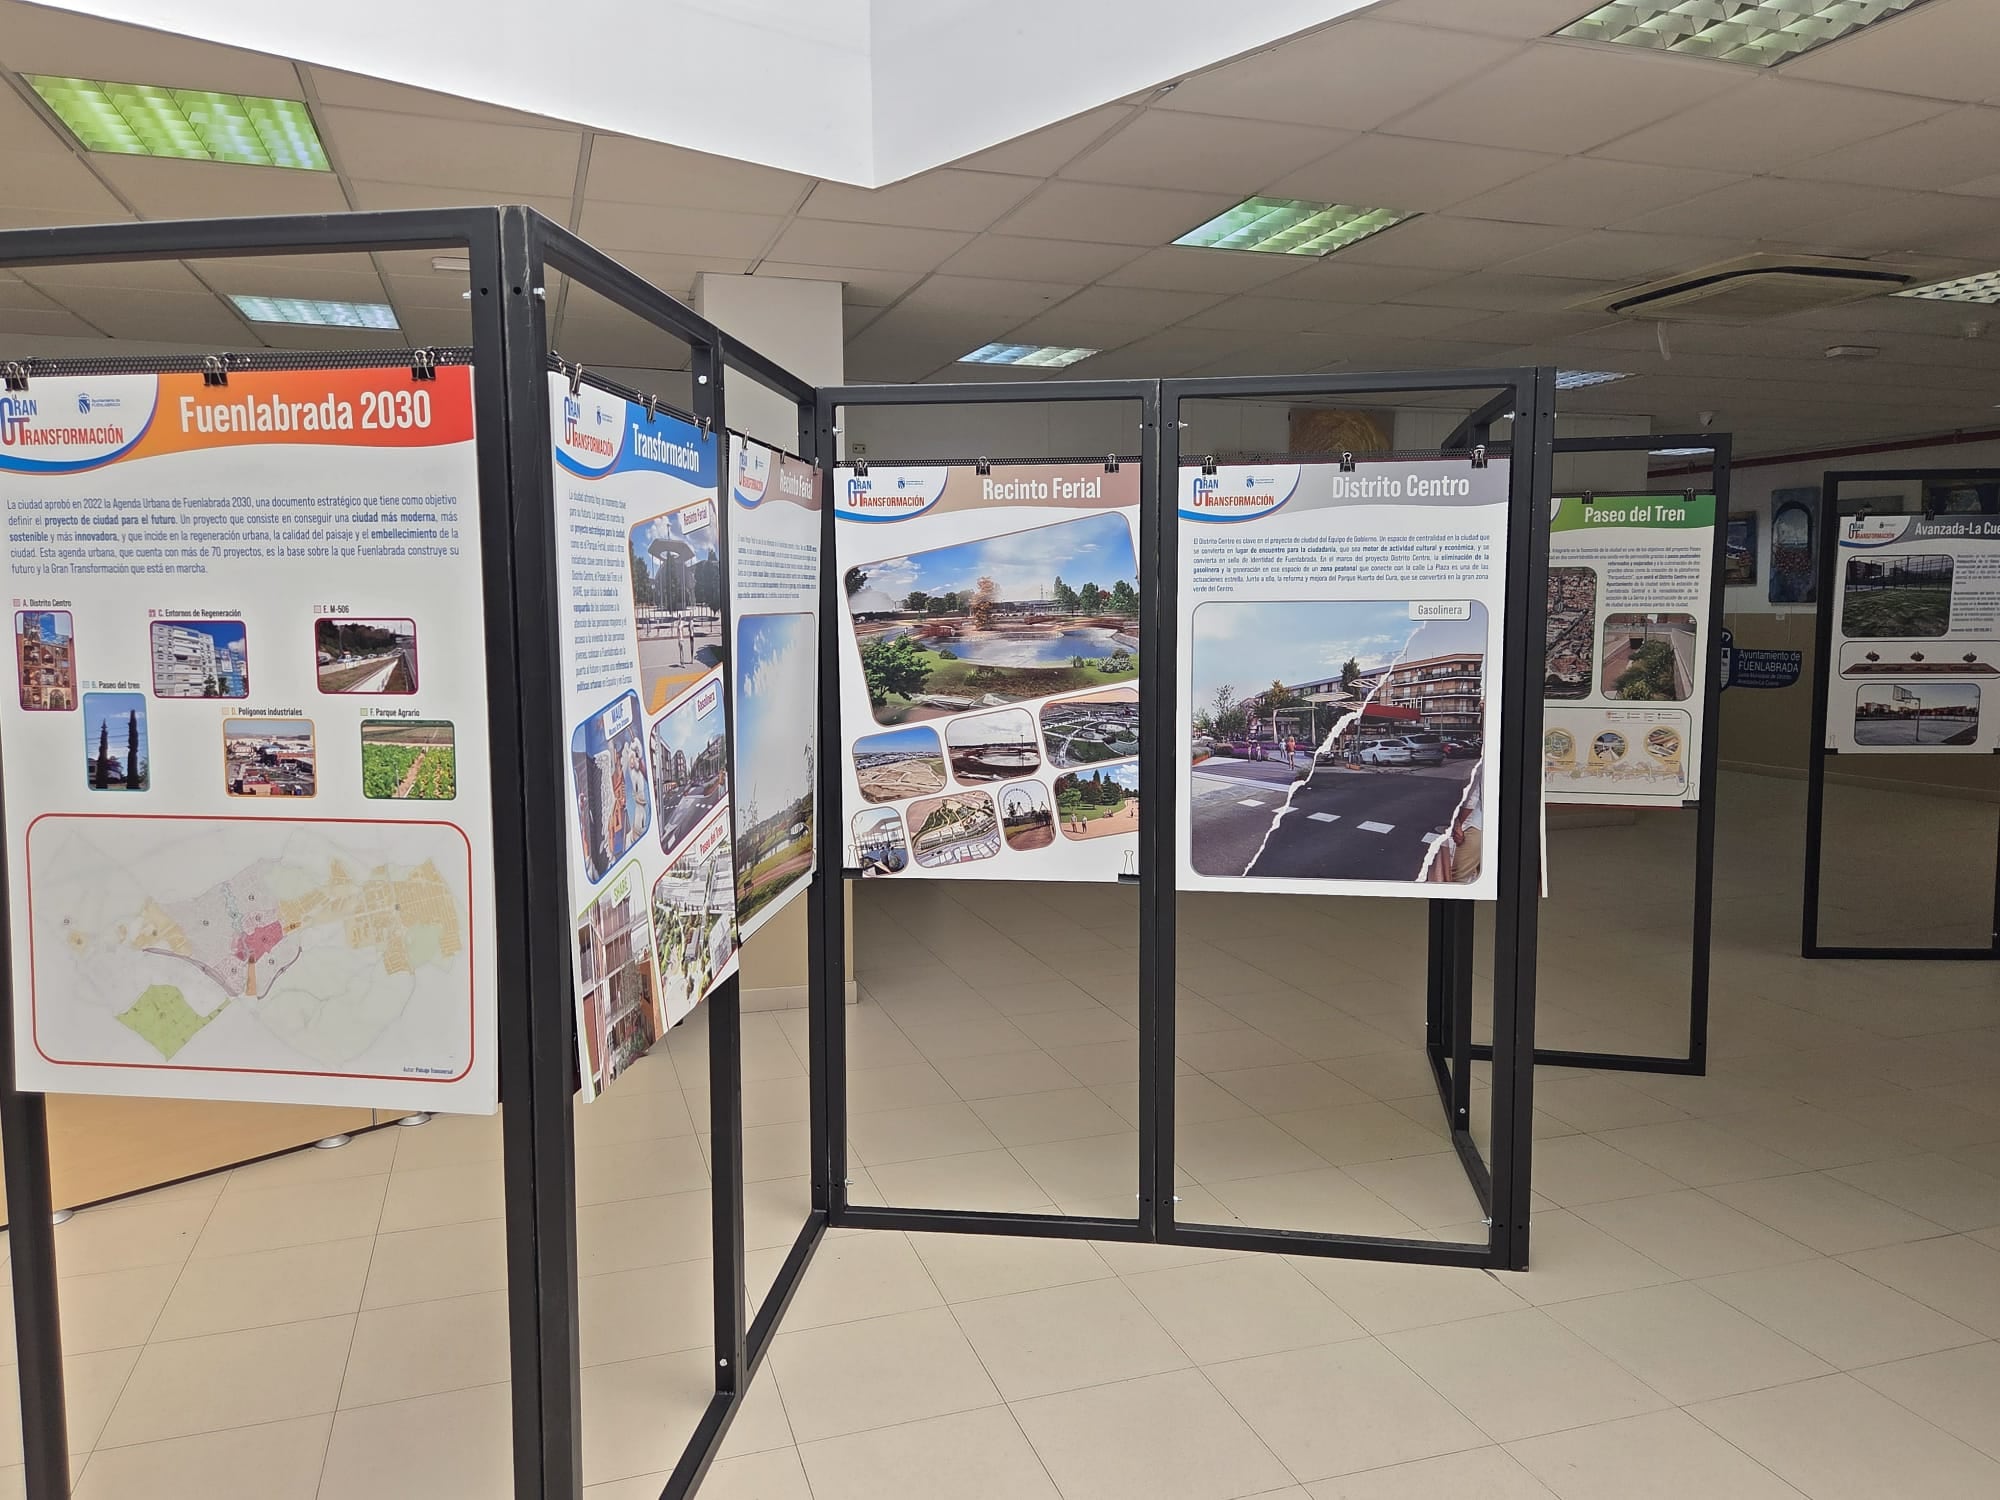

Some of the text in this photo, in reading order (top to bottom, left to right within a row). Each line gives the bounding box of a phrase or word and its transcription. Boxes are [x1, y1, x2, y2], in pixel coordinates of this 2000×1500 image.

[180, 390, 431, 433] Fuenlabrada 2030
[8, 417, 124, 445] TRANSFORMACIÓN
[633, 423, 699, 472] Transformación
[780, 468, 813, 500] Recinto Ferial
[983, 477, 1101, 500] Recinto Ferial
[1332, 475, 1470, 499] Distrito Centro
[7, 500, 16, 510] La
[18, 499, 42, 510] ciudad
[44, 499, 70, 512] aprobó
[72, 501, 82, 509] en
[84, 499, 102, 509] 2022
[104, 499, 111, 509] la
[113, 498, 141, 511] Agenda
[143, 498, 170, 508] Urbana
[172, 498, 181, 508] de
[183, 497, 230, 508] Fuenlabrada
[232, 497, 254, 508] 2030,
[256, 499, 270, 507] una
[272, 496, 315, 507] documento
[317, 496, 361, 509] estratégico
[363, 498, 377, 508] que
[379, 496, 399, 506] tiene
[425, 495, 457, 508] objetivo
[852, 491, 924, 507] TRANSFORMACIÓN
[1198, 490, 1274, 506] TRANSFORMACIÓN
[8, 516, 32, 526] definir
[35, 515, 41, 525] el
[44, 515, 78, 528] proyecto
[81, 515, 90, 525] de
[93, 515, 118, 525] ciudad
[121, 517, 139, 527] para
[142, 515, 148, 524] el
[151, 514, 178, 524] futuro.
[180, 514, 190, 524] Un
[193, 514, 227, 527] proyecto
[230, 516, 245, 526] que
[247, 513, 279, 524] consiste
[294, 513, 332, 526] conseguir
[335, 515, 349, 523] una
[352, 513, 378, 523] ciudad
[381, 512, 397, 522] más
[400, 512, 438, 523] moderna,
[441, 512, 458, 522] más
[1584, 506, 1685, 522] Paseo del Tren
[9, 531, 48, 542] sostenible
[50, 534, 55, 544] y
[57, 531, 72, 541] más
[75, 531, 119, 542] innovadora,
[122, 533, 126, 543] y
[128, 533, 142, 543] que
[144, 531, 167, 540] incide
[181, 530, 188, 540] la
[190, 530, 238, 543] regeneración
[242, 530, 272, 541] urbana,
[273, 530, 281, 539] la
[282, 529, 310, 539] calidad
[312, 529, 323, 539] del
[326, 529, 353, 542] paisaje
[355, 531, 360, 541] y
[362, 529, 369, 539] el
[371, 528, 437, 539] embellecimiento
[439, 528, 449, 538] de
[451, 528, 458, 538] la
[1915, 522, 1981, 535] Avanzada-La
[11, 548, 36, 557] ciudad.
[40, 547, 56, 557] Esta
[58, 547, 86, 560] agenda
[88, 547, 117, 558] urbana,
[119, 549, 134, 560] que
[136, 547, 162, 557] cuenta
[165, 549, 178, 557] con
[181, 547, 197, 557] más
[200, 547, 209, 556] de
[212, 547, 221, 556] 70
[224, 546, 264, 559] proyectos,
[277, 546, 284, 556] la
[287, 546, 305, 556] base
[308, 546, 329, 556] sobre
[331, 546, 338, 556] la
[341, 548, 355, 558] que
[358, 546, 405, 556] Fuenlabrada
[407, 545, 447, 558] construye
[12, 564, 35, 574] futuro
[37, 566, 41, 576] y
[43, 564, 49, 574] la
[51, 564, 68, 574] Gran
[70, 563, 129, 573] Transformación
[131, 566, 145, 576] que
[147, 563, 163, 573] está
[177, 563, 207, 573] marcha.
[193, 609, 200, 617] de
[202, 609, 241, 618] Regeneración
[330, 605, 349, 613] M-506
[1418, 605, 1462, 615] Gasolinera
[1738, 650, 1800, 660] Ayuntamiento de
[1739, 661, 1798, 672] FUENLABRADA
[239, 708, 266, 717] Polígonos
[376, 709, 396, 718] Parque
[398, 709, 420, 718] Agrario
